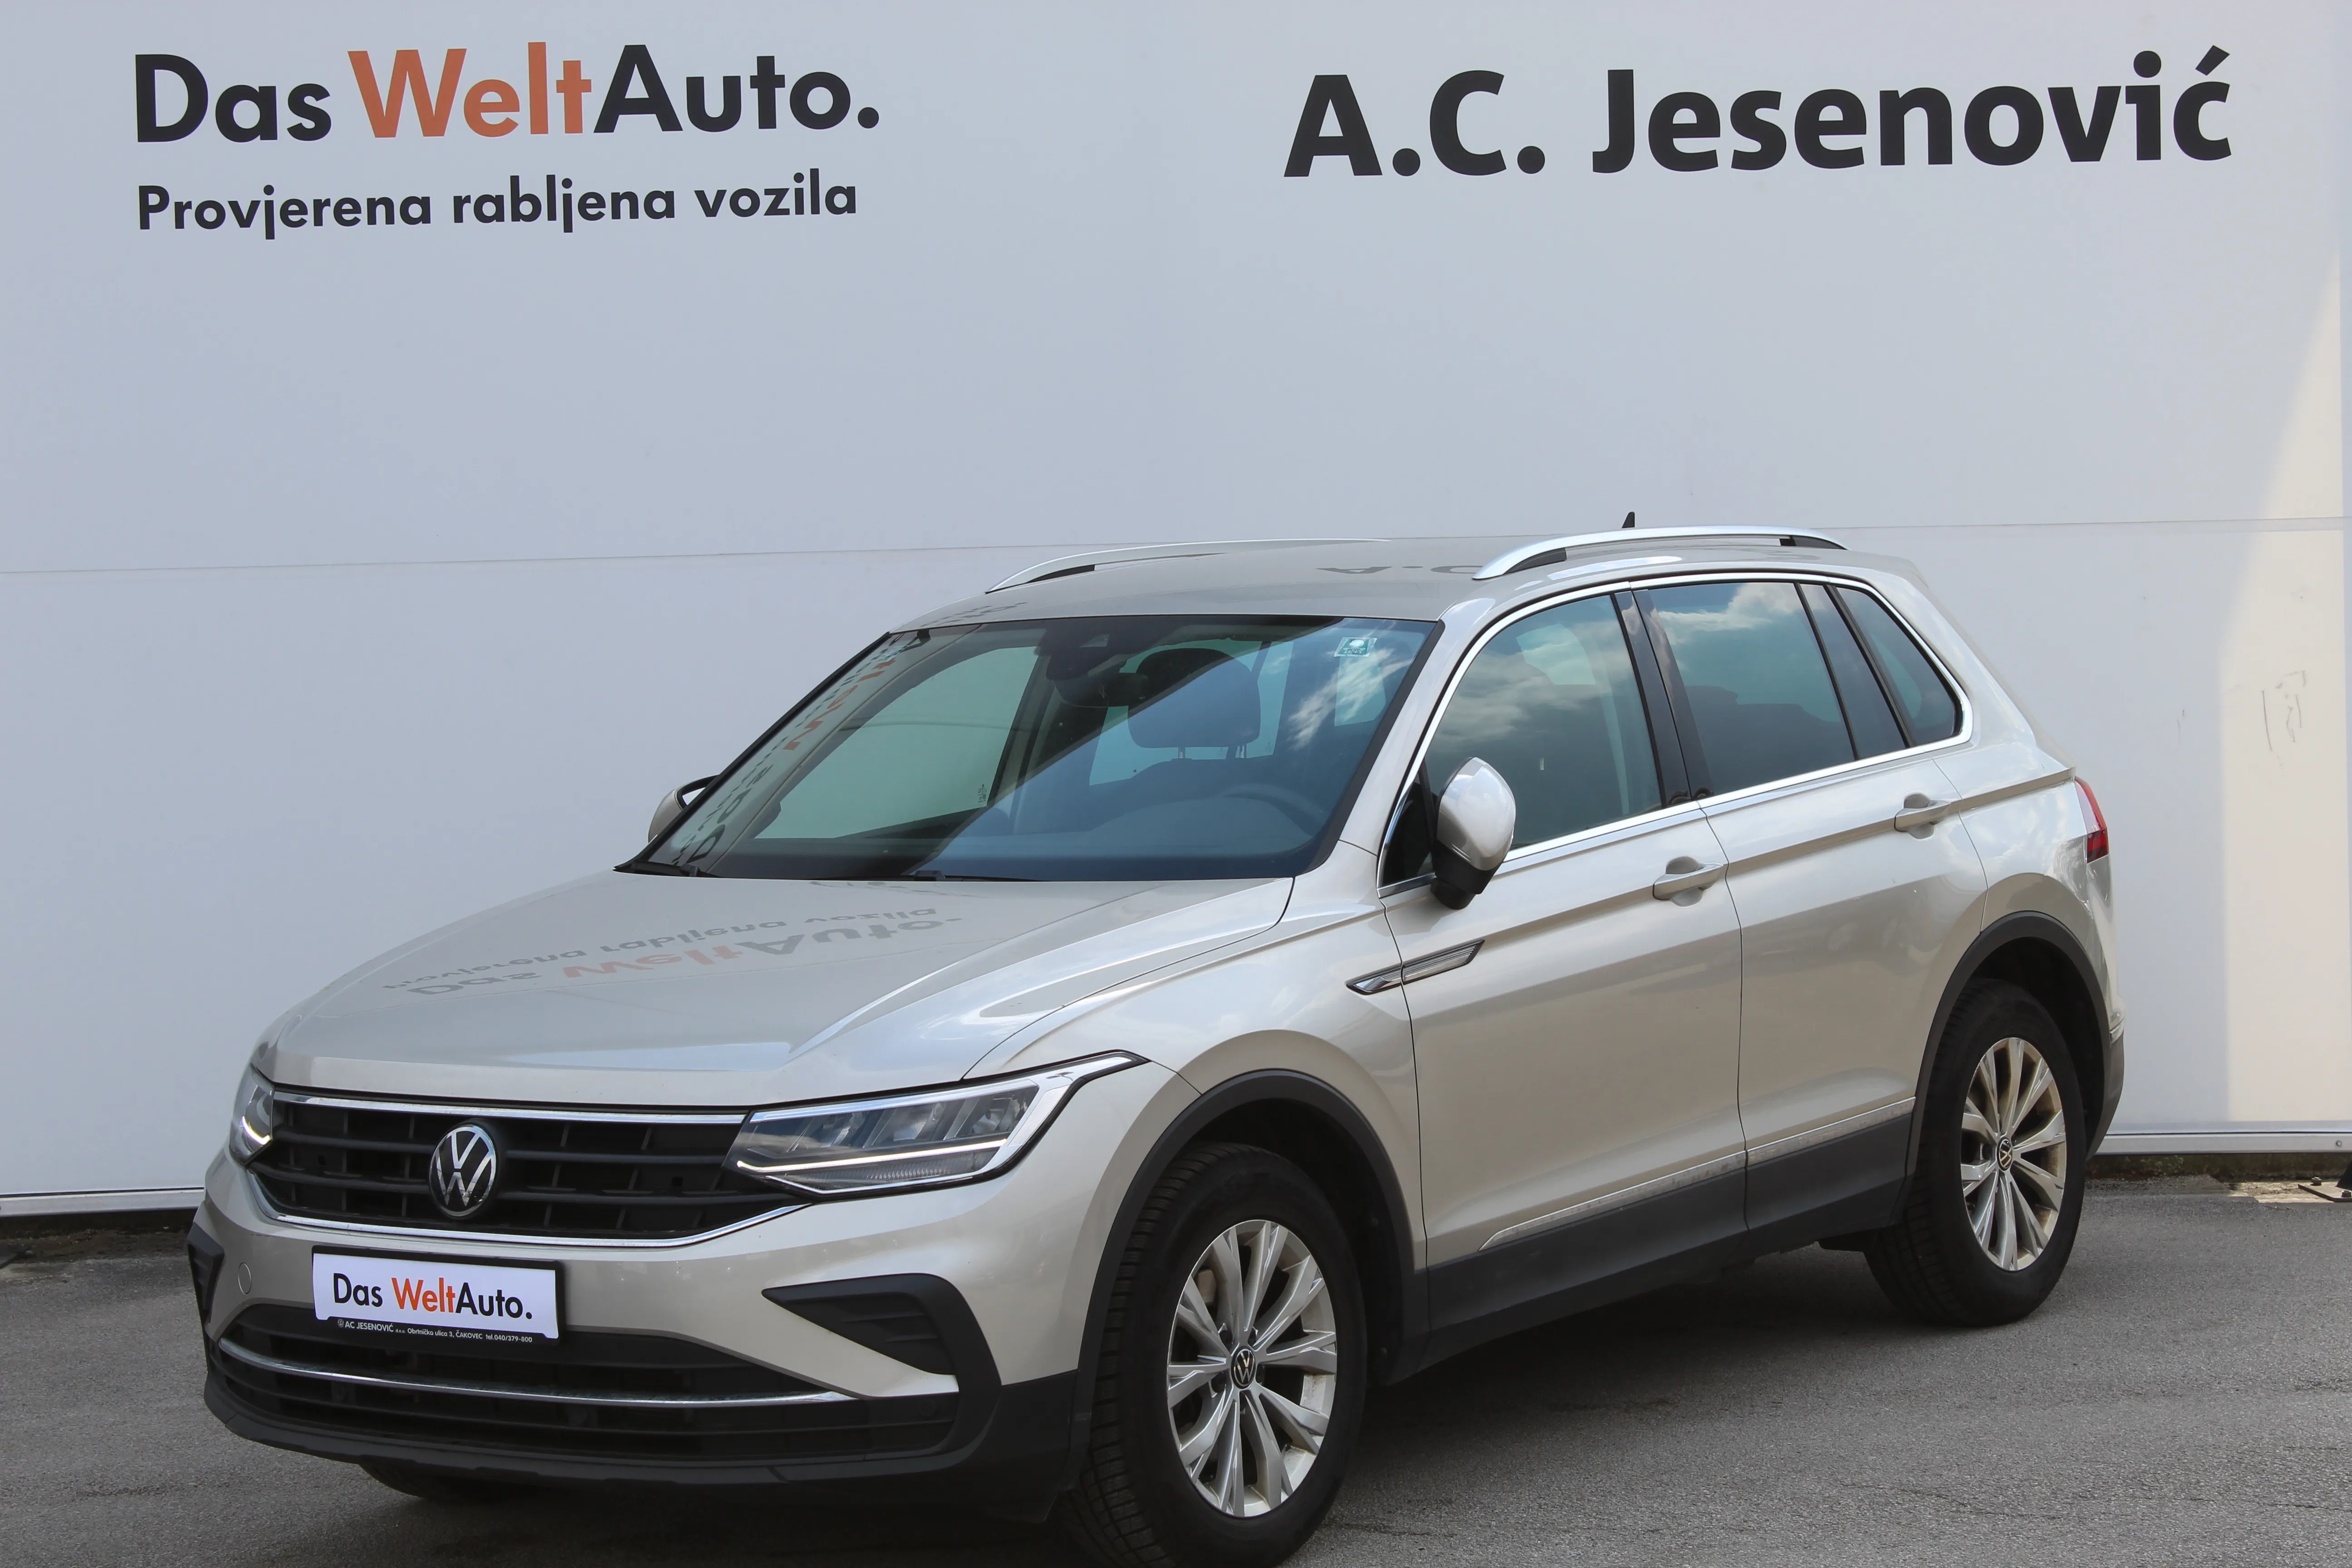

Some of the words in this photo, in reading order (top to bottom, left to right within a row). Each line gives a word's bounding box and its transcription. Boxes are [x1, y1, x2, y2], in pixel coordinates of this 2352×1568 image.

[135, 54, 331, 142] Das
[348, 42, 879, 137] WeltAuto.
[1284, 70, 1545, 177] A.C.
[1592, 45, 2231, 173] Jesenović
[139, 185, 431, 240] Provjerena
[453, 175, 675, 233] rabljena
[694, 168, 856, 217] vozila
[333, 1273, 382, 1307] Das
[392, 1278, 532, 1319] WeltAuto.
[357, 1322, 394, 1332] JESENOVIĆ
[456, 1330, 483, 1339] ČAKOVEC
